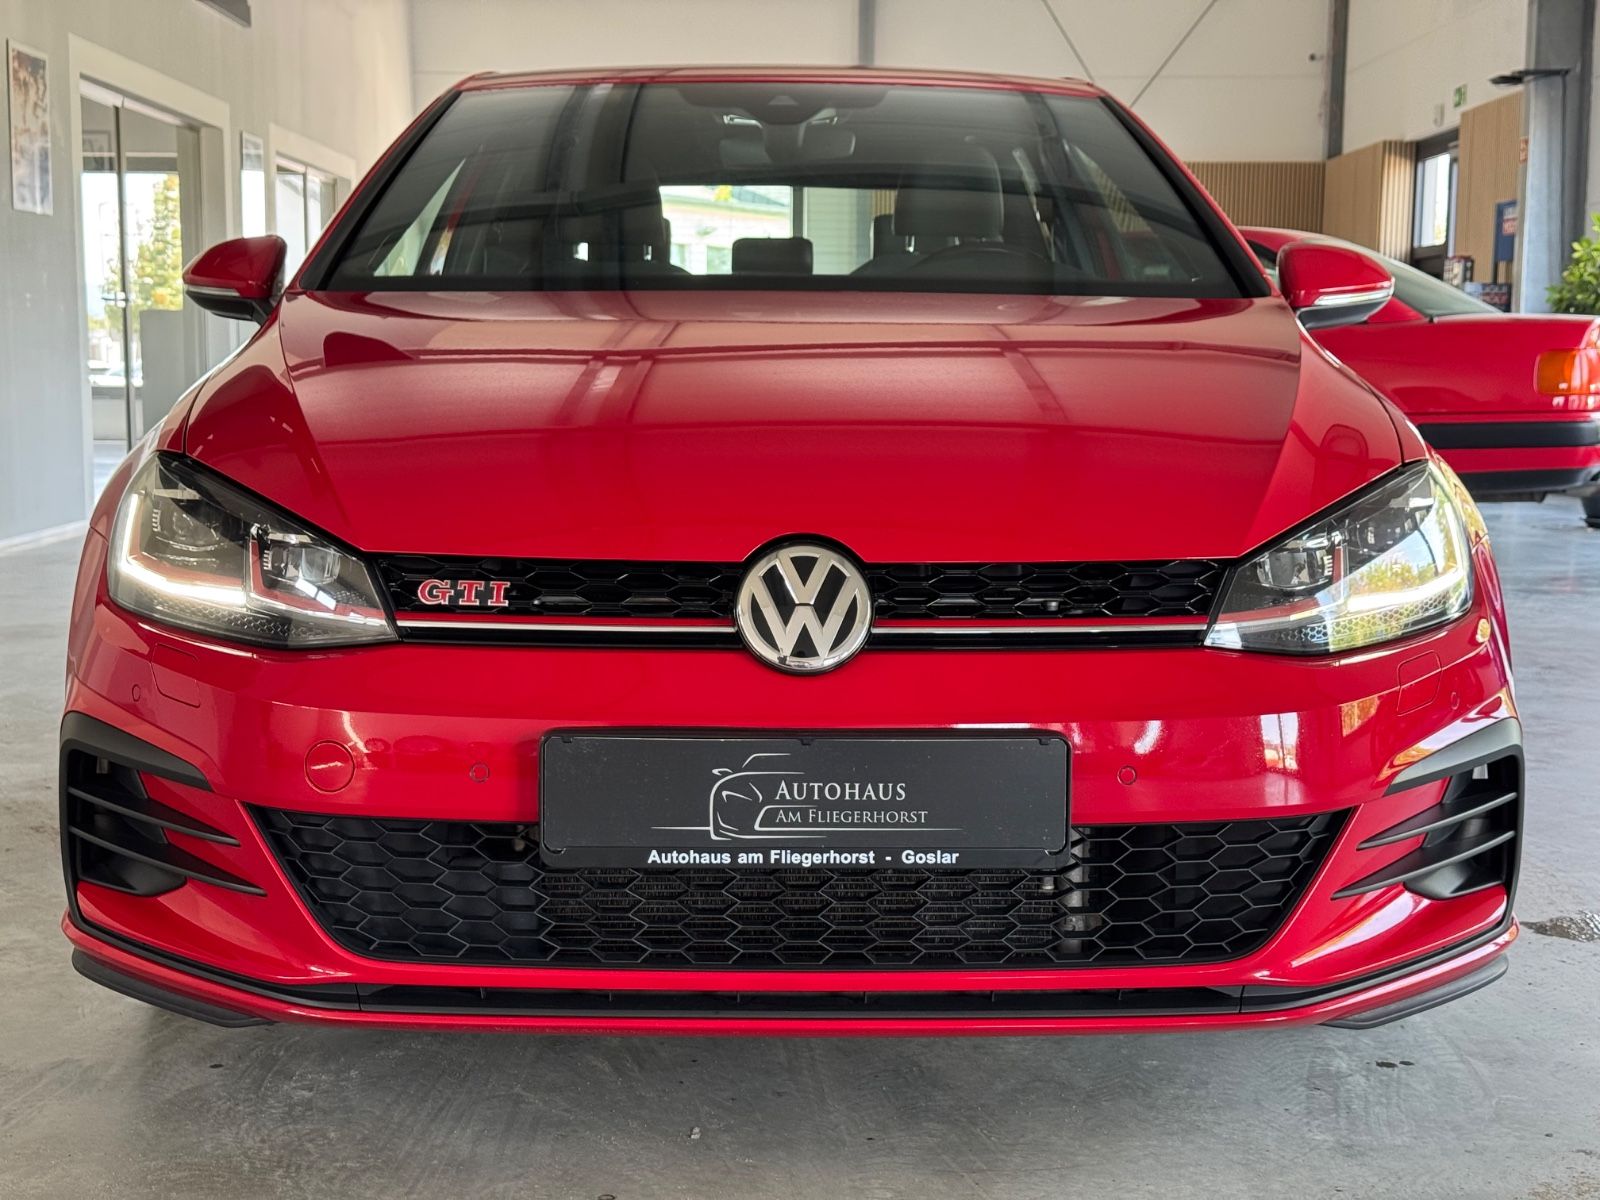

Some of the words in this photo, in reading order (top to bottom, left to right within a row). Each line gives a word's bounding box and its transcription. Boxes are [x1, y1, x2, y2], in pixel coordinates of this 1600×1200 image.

[417, 578, 511, 607] GTI
[775, 779, 906, 801] AUTOHAUS
[775, 809, 802, 823] AM
[808, 808, 928, 824] FLIEGERHORST
[647, 849, 732, 865] Autohaus
[737, 852, 764, 865] am
[770, 849, 876, 868] Fliegerhorst
[901, 849, 960, 865] Goslar
